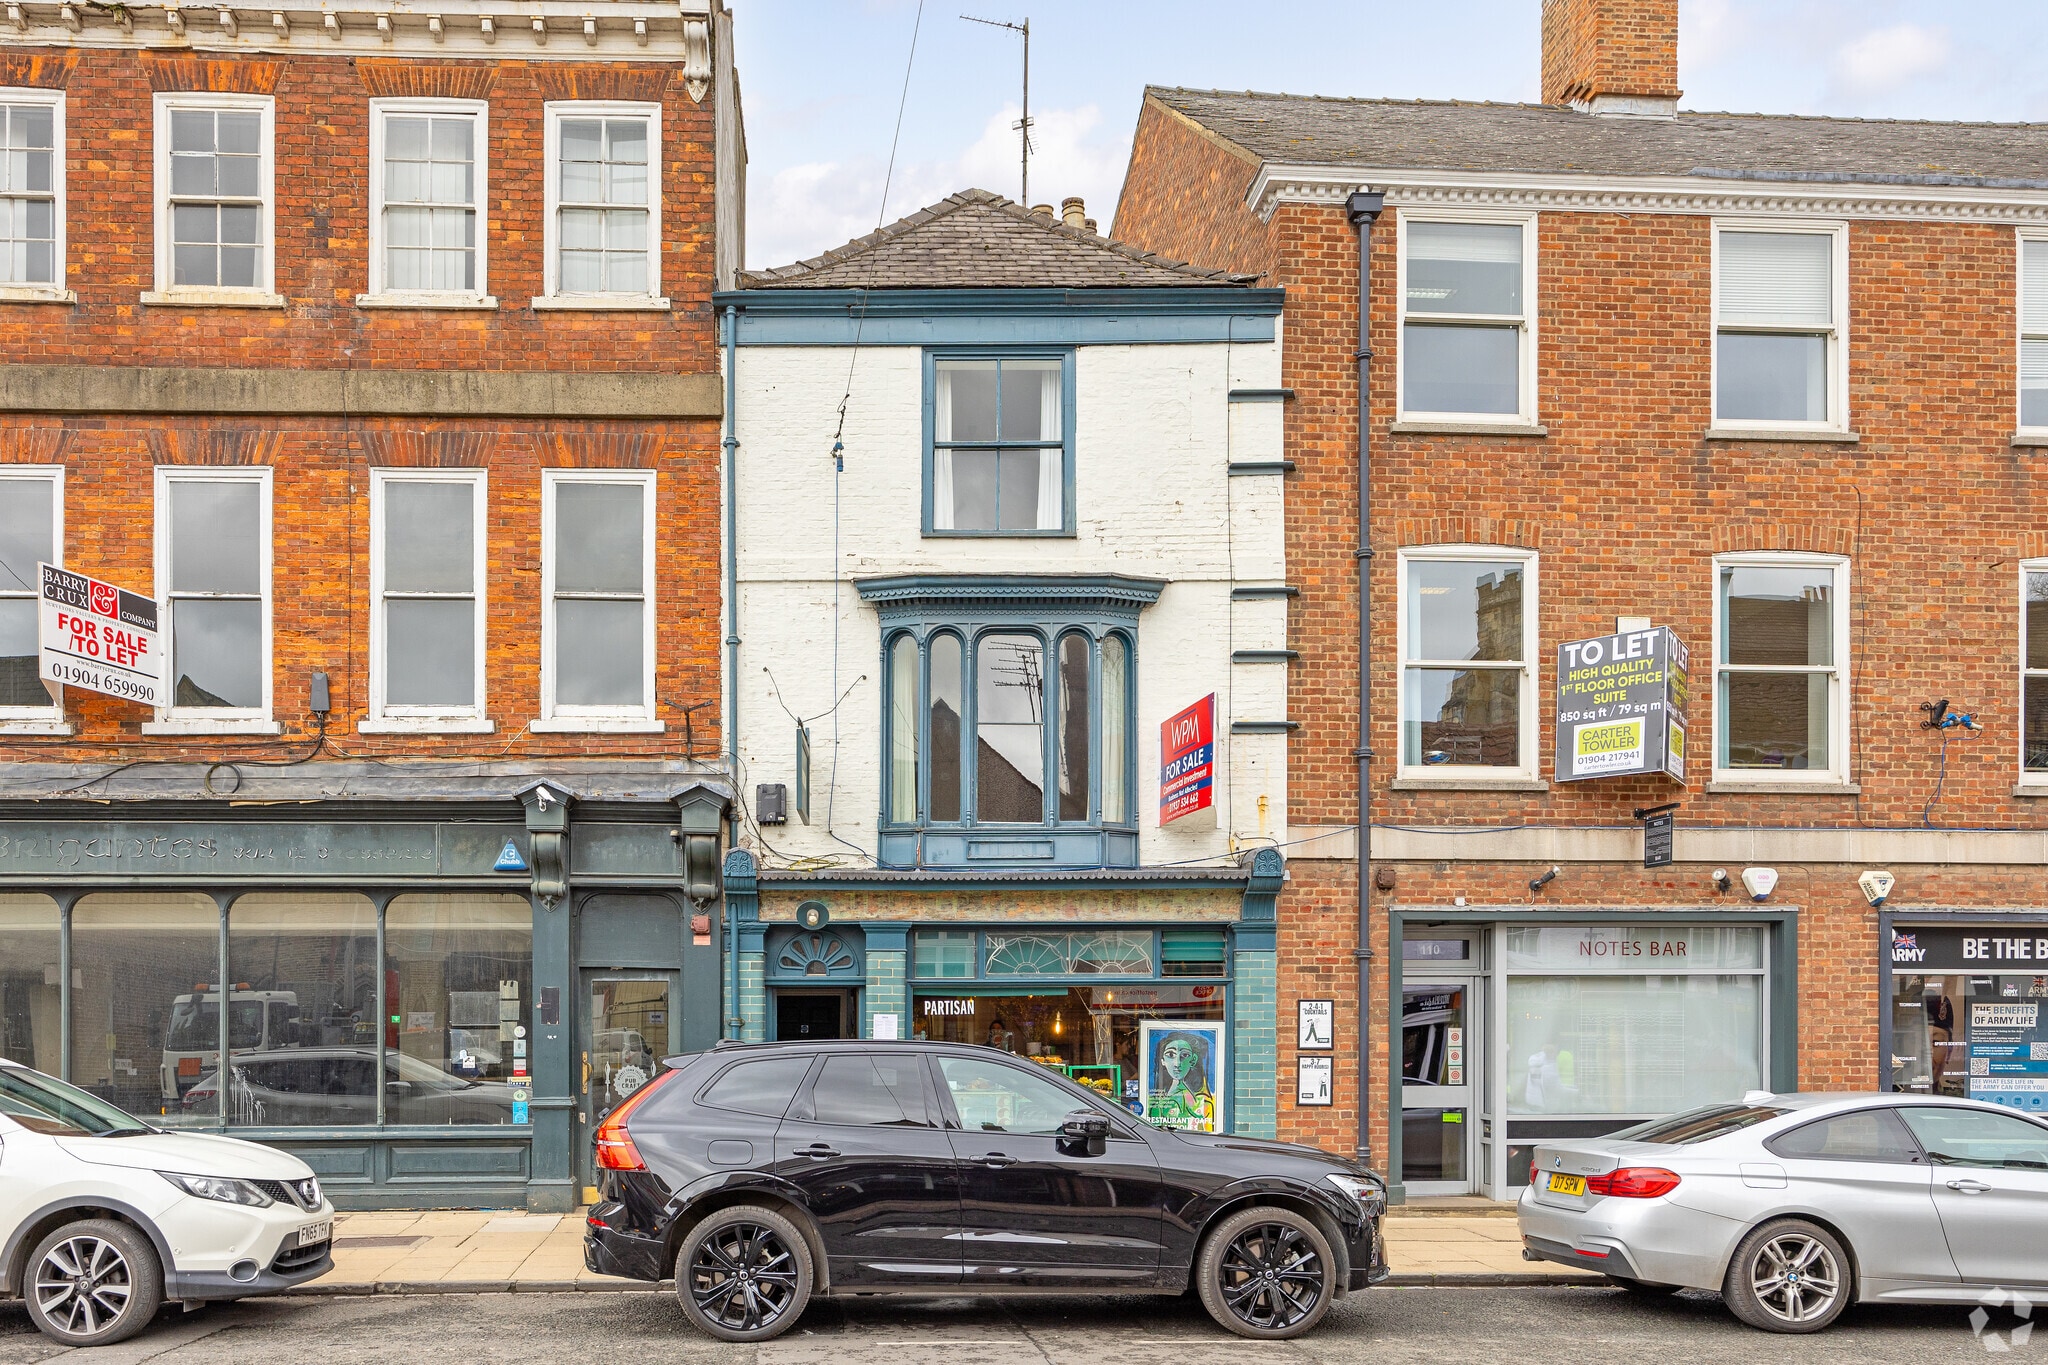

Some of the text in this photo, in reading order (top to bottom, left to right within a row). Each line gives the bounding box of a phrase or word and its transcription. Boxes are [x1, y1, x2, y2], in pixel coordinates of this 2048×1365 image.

[44, 569, 87, 593] BARRY
[44, 585, 88, 608] CRUX
[92, 585, 117, 615] &
[45, 601, 75, 614] SURVEYORS
[121, 611, 156, 629] COMPANY
[58, 612, 148, 654] FOR SALE
[69, 634, 139, 667] /TO LET
[1565, 630, 1660, 668] TO LET
[1668, 634, 1688, 671] TO LET
[76, 659, 132, 678] www.barrycrux.co.uk
[1569, 658, 1655, 682] HIGH QUALITY
[52, 662, 154, 701] 01904 659990
[1575, 676, 1615, 694] FLOOR
[1618, 671, 1663, 688] OFFICE
[1593, 690, 1627, 705] SUITE
[1560, 710, 1580, 723] 850
[1583, 711, 1596, 720] sq
[1598, 707, 1607, 718] ft
[1618, 704, 1632, 715] 79
[1634, 704, 1648, 714] sq
[1650, 702, 1661, 711] m
[1171, 713, 1200, 750] WPM
[1582, 726, 1631, 741] CARTER
[1583, 736, 1635, 752] TOWLER
[1165, 747, 1204, 782] FOR SALE
[1577, 751, 1640, 765] 01904 217941
[1584, 761, 1632, 771] cartertowler.co.uk
[1163, 766, 1207, 795] Commercial Investment
[1181, 795, 1189, 808] 534
[1421, 944, 1440, 955] 110
[1580, 941, 1687, 957] NOTES BAR
[1962, 938, 1990, 959] BE
[1992, 938, 2032, 960] THE
[924, 1000, 975, 1015] PARTISAN
[1974, 1006, 1992, 1014] THE
[1993, 1006, 2036, 1015] BENEFITS
[1974, 1016, 2034, 1025] OF ARMY LIFE
[1310, 1058, 1320, 1066] 3-7
[1553, 1175, 1580, 1192] D7 SPW
[302, 1221, 328, 1241] FN65 TFK
